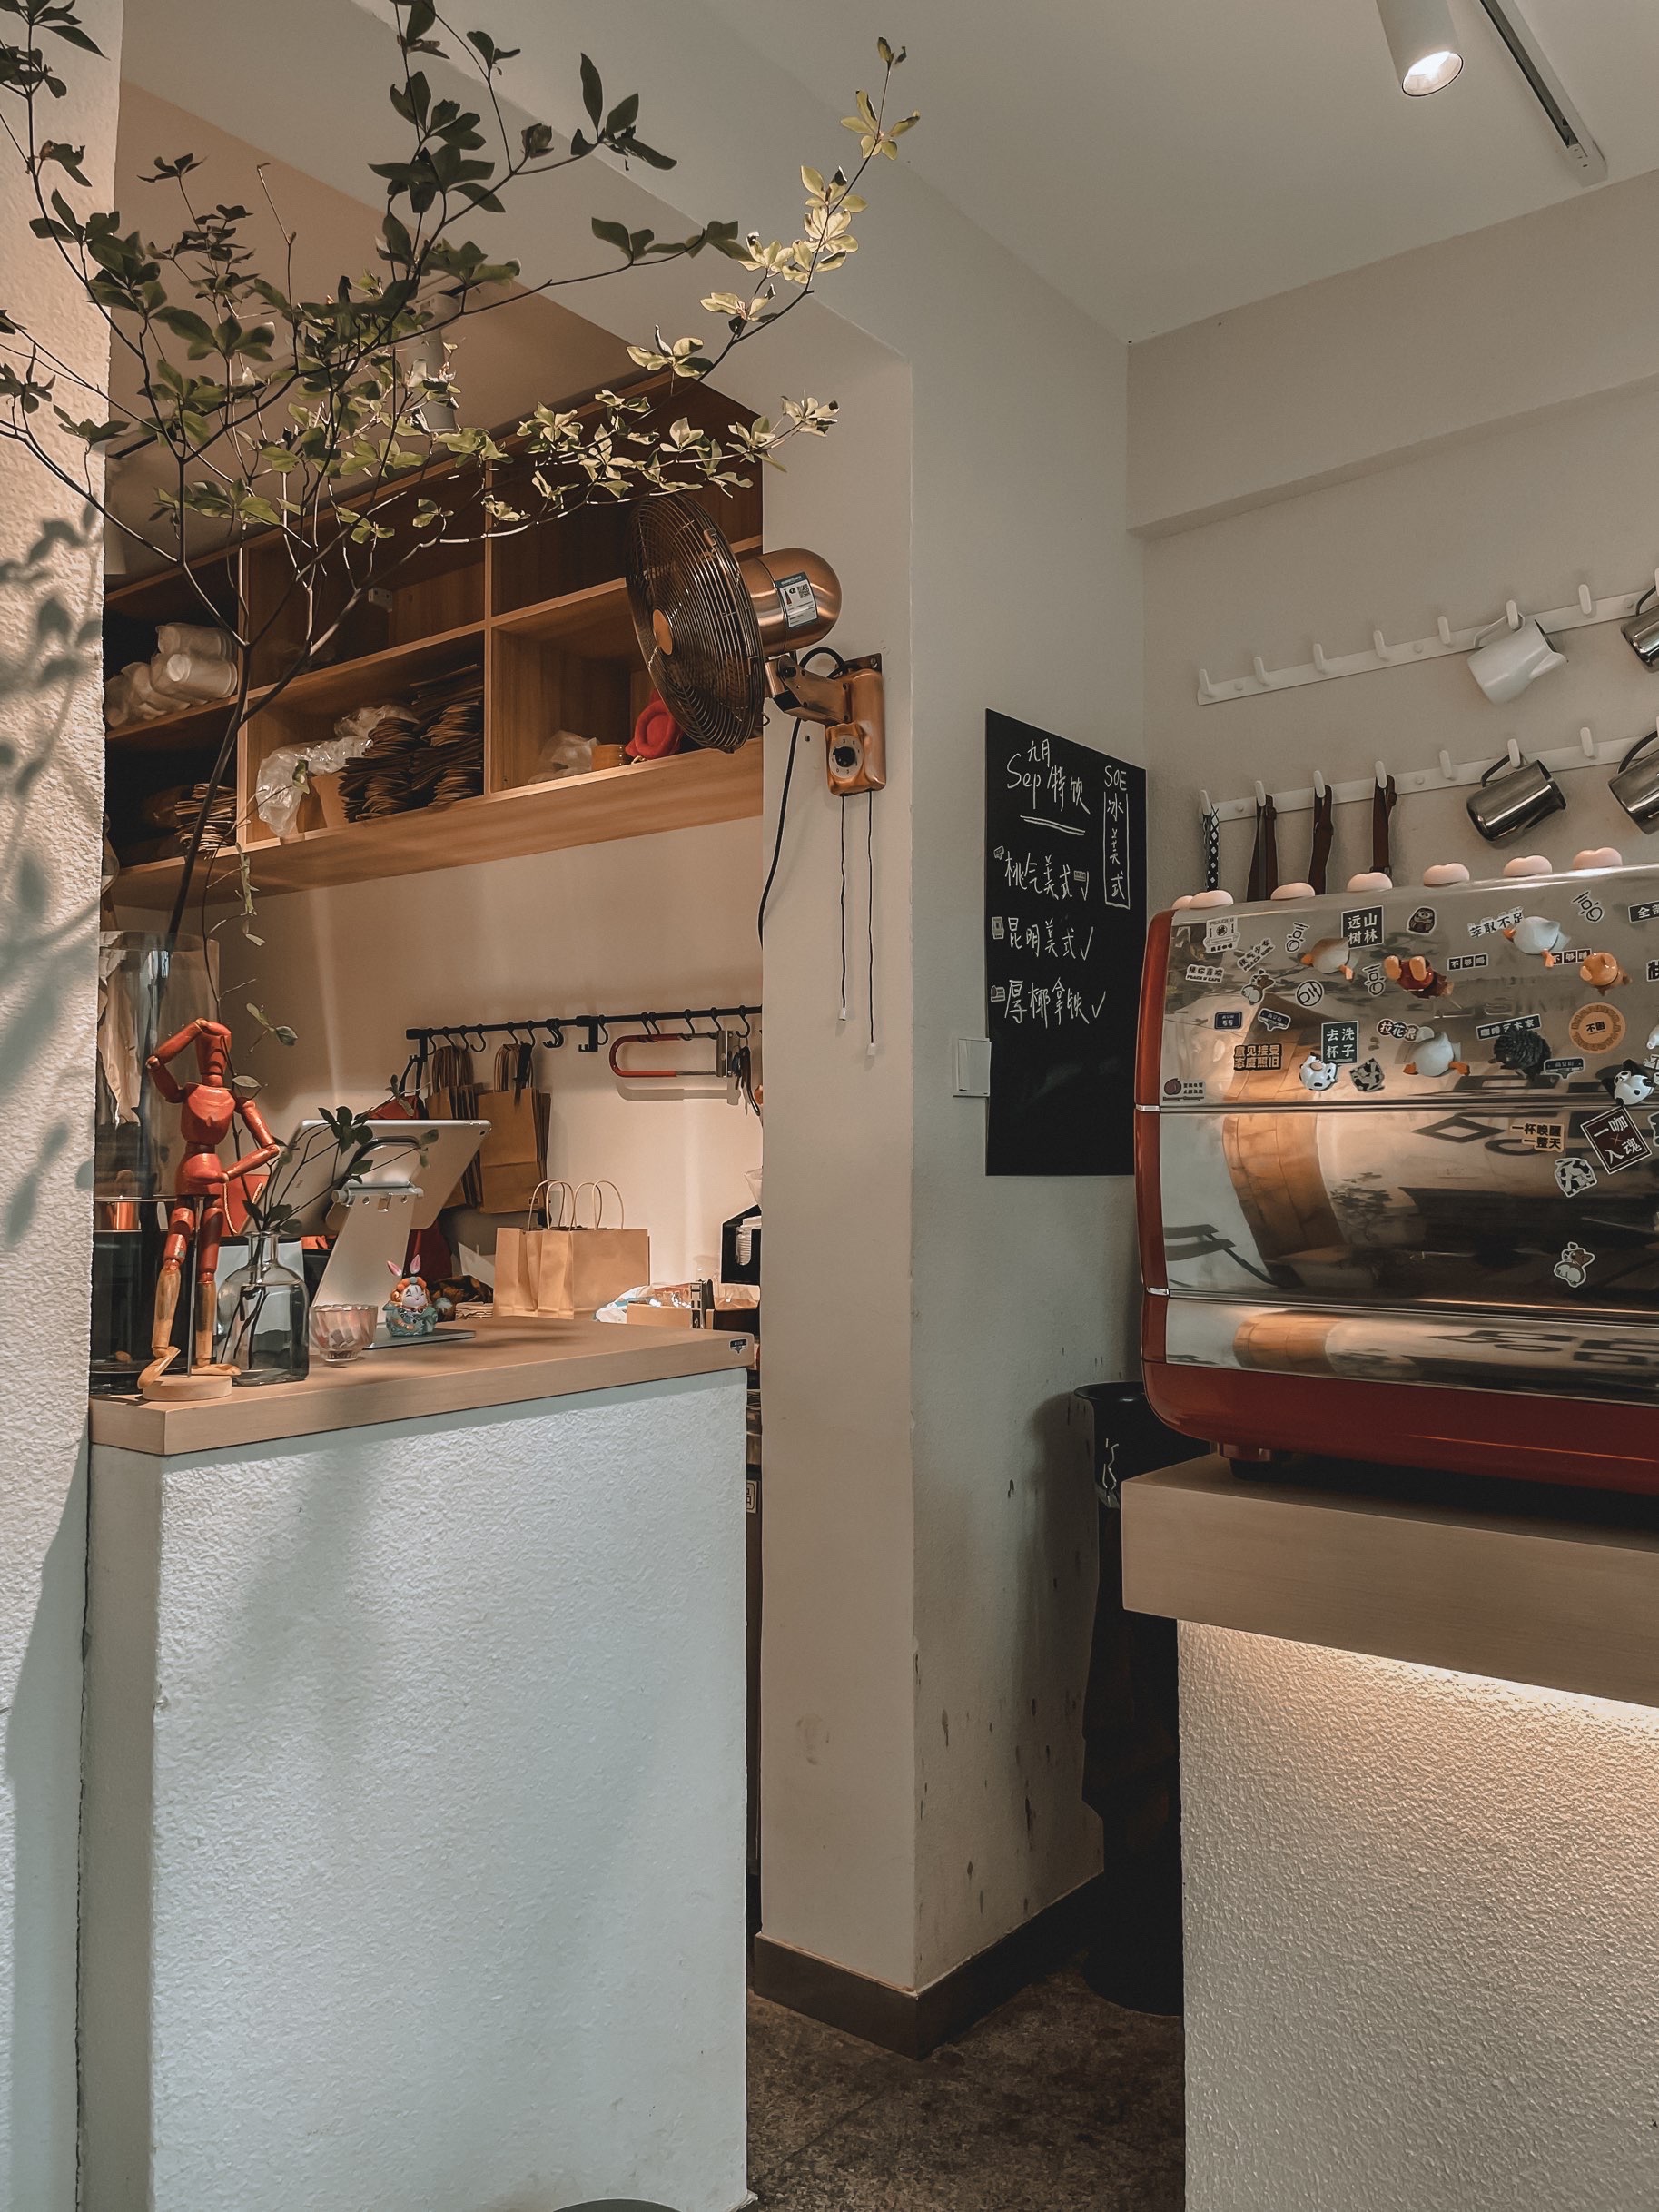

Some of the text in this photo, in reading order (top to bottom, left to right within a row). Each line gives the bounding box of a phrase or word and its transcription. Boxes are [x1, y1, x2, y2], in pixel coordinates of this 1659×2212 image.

[1027, 739, 1050, 767] 九月
[1007, 753, 1091, 815] Sep 特饮
[1104, 765, 1127, 791] SOE
[1348, 913, 1378, 930] 远山
[1008, 917, 1076, 960] 昆明美式
[1348, 928, 1378, 944] 树林
[1004, 977, 1090, 1029] 厚椰拿铁
[1326, 1027, 1355, 1042] 去洗
[1326, 1043, 1355, 1059] 杯子
[1594, 1115, 1628, 1137] 一咖
[1524, 1136, 1561, 1150] 一整天
